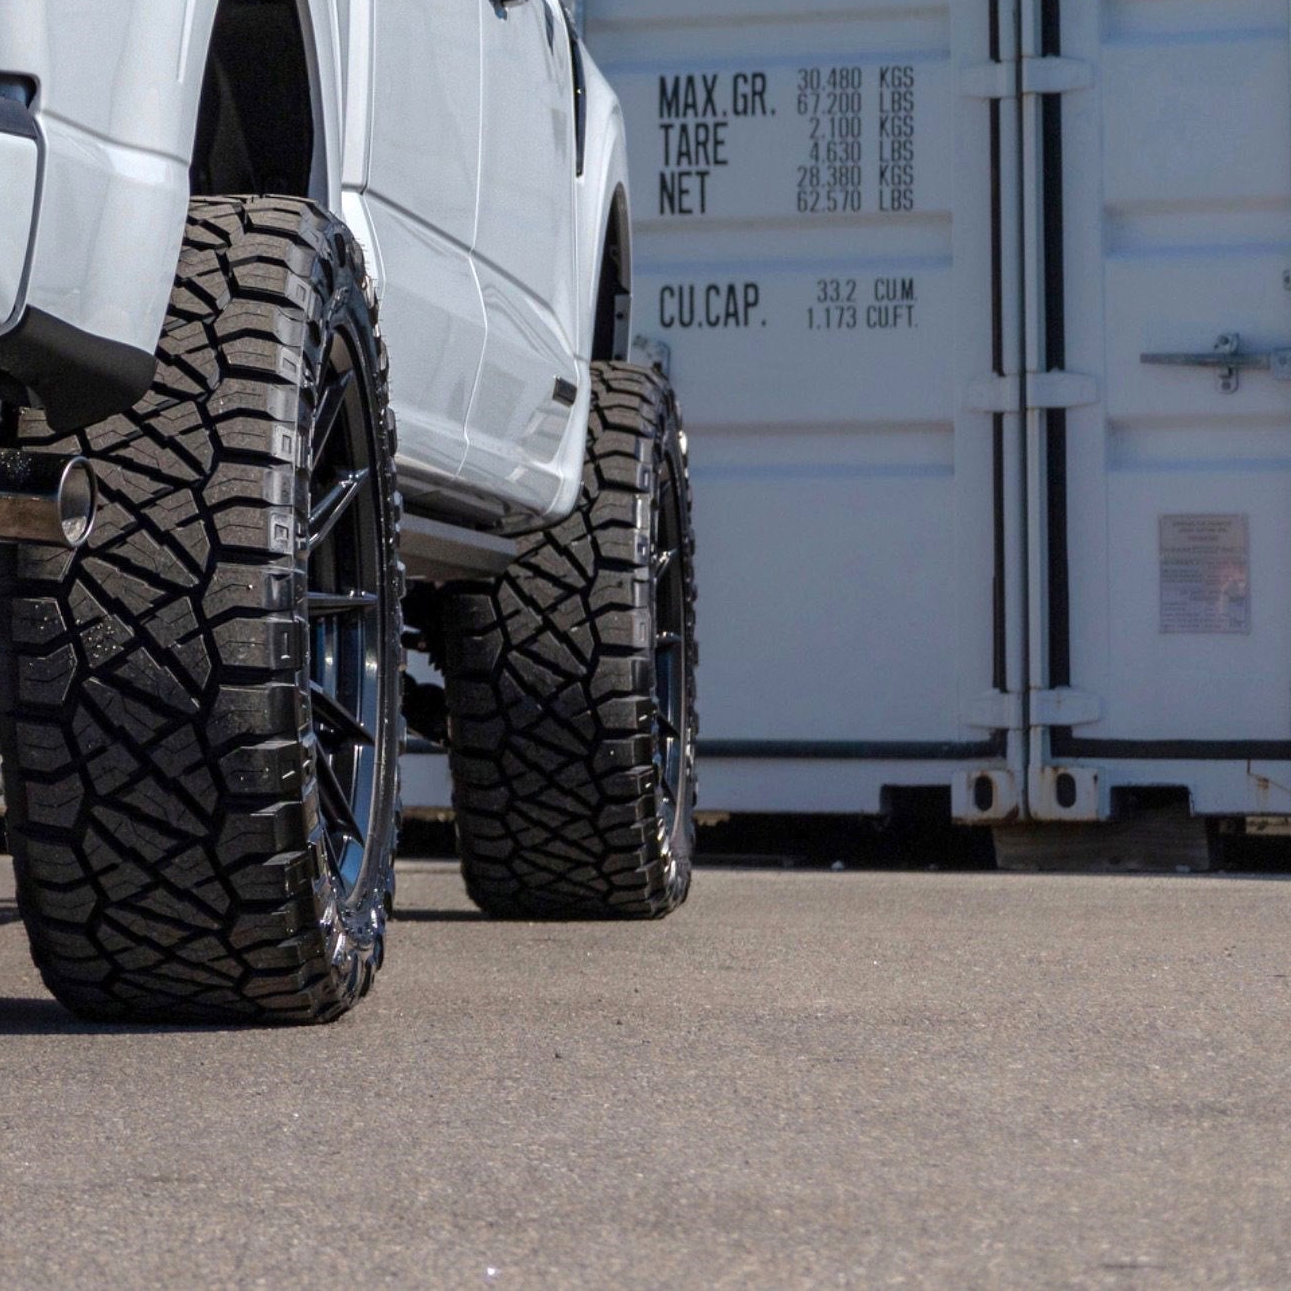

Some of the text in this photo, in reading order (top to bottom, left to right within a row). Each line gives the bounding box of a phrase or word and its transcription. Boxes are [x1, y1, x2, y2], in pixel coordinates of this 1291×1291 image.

[797, 66, 915, 91] 30.480 KGS
[659, 72, 776, 118] MAX.GR.
[797, 90, 915, 115] 67.200 LBS
[809, 115, 915, 140] 2.100 KGS
[659, 121, 729, 166] TARE
[809, 139, 915, 164] 4.630 LBS
[797, 164, 915, 188] 28.380 KGS
[659, 171, 711, 214] NET
[879, 188, 915, 211] LBS
[817, 279, 857, 303] 33.2
[659, 283, 767, 328] CU.CAP.
[807, 306, 857, 329] 1.173
